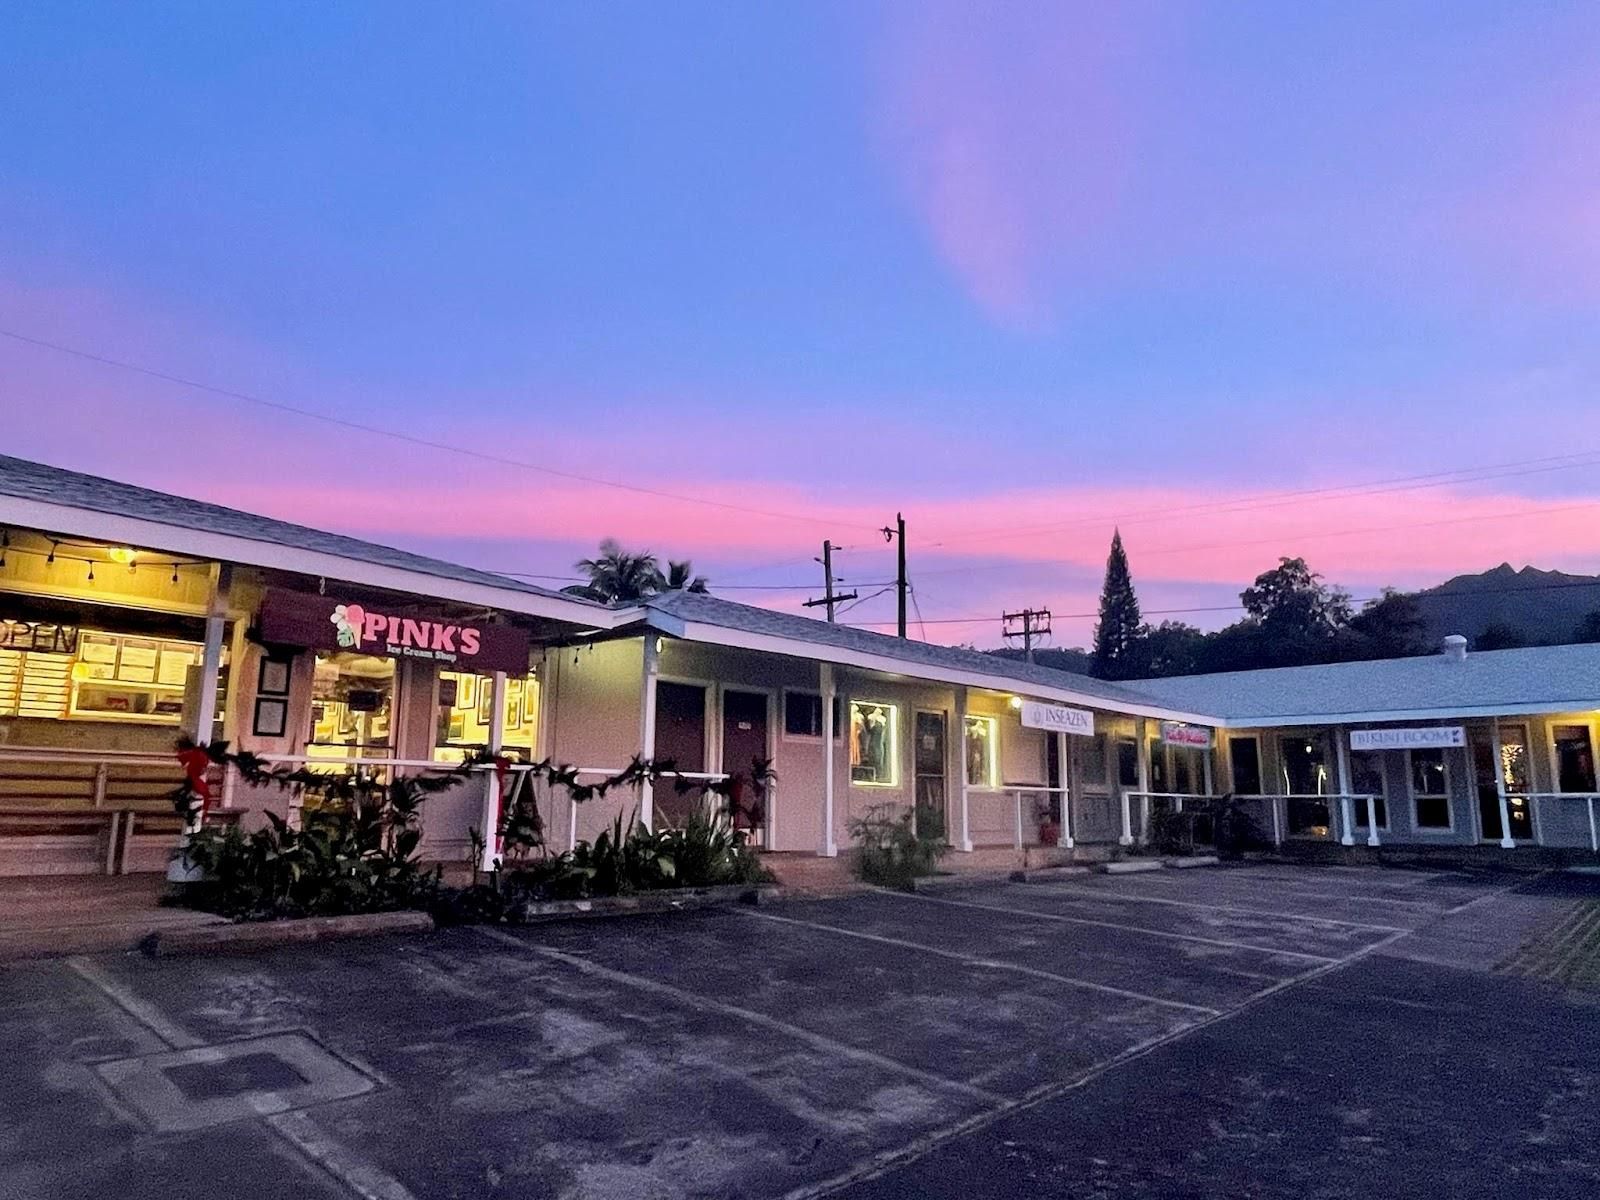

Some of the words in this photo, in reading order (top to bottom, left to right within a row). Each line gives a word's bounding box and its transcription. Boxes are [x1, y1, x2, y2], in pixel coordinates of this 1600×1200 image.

[362, 612, 480, 656] PINK'S
[386, 644, 401, 655] Ice
[403, 647, 433, 659] Cream
[435, 652, 457, 663] Shop
[1404, 731, 1449, 743] ROOM
